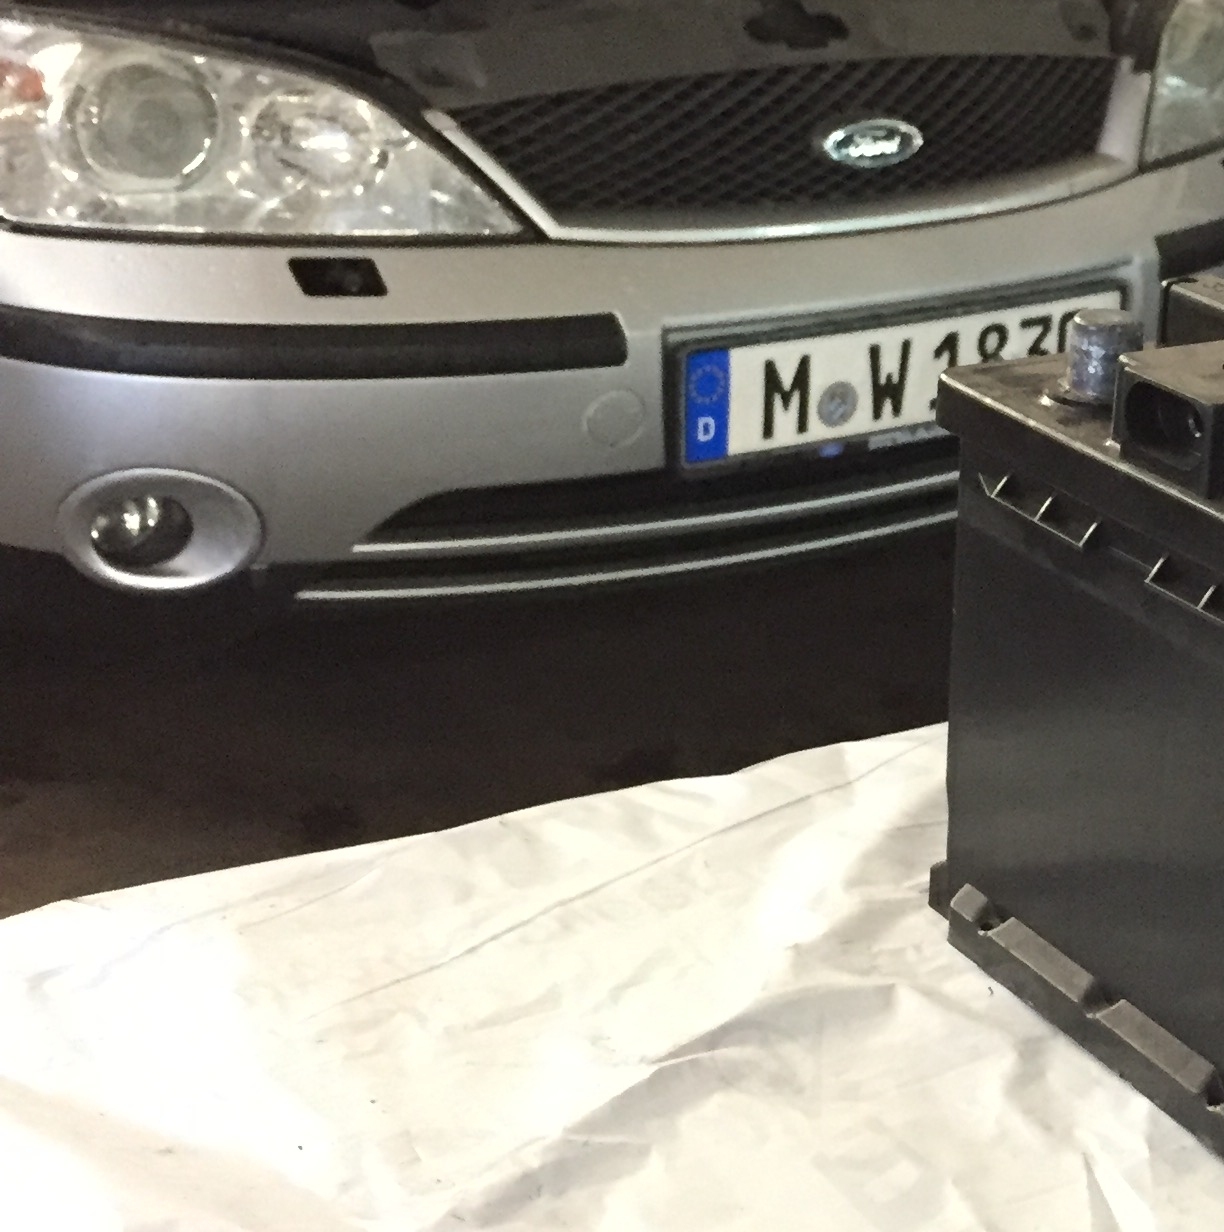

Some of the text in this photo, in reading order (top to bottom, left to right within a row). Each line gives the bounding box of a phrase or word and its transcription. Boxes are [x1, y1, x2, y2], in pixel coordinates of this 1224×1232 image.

[763, 354, 811, 439] M
[870, 337, 911, 421] W
[697, 416, 715, 442] D
